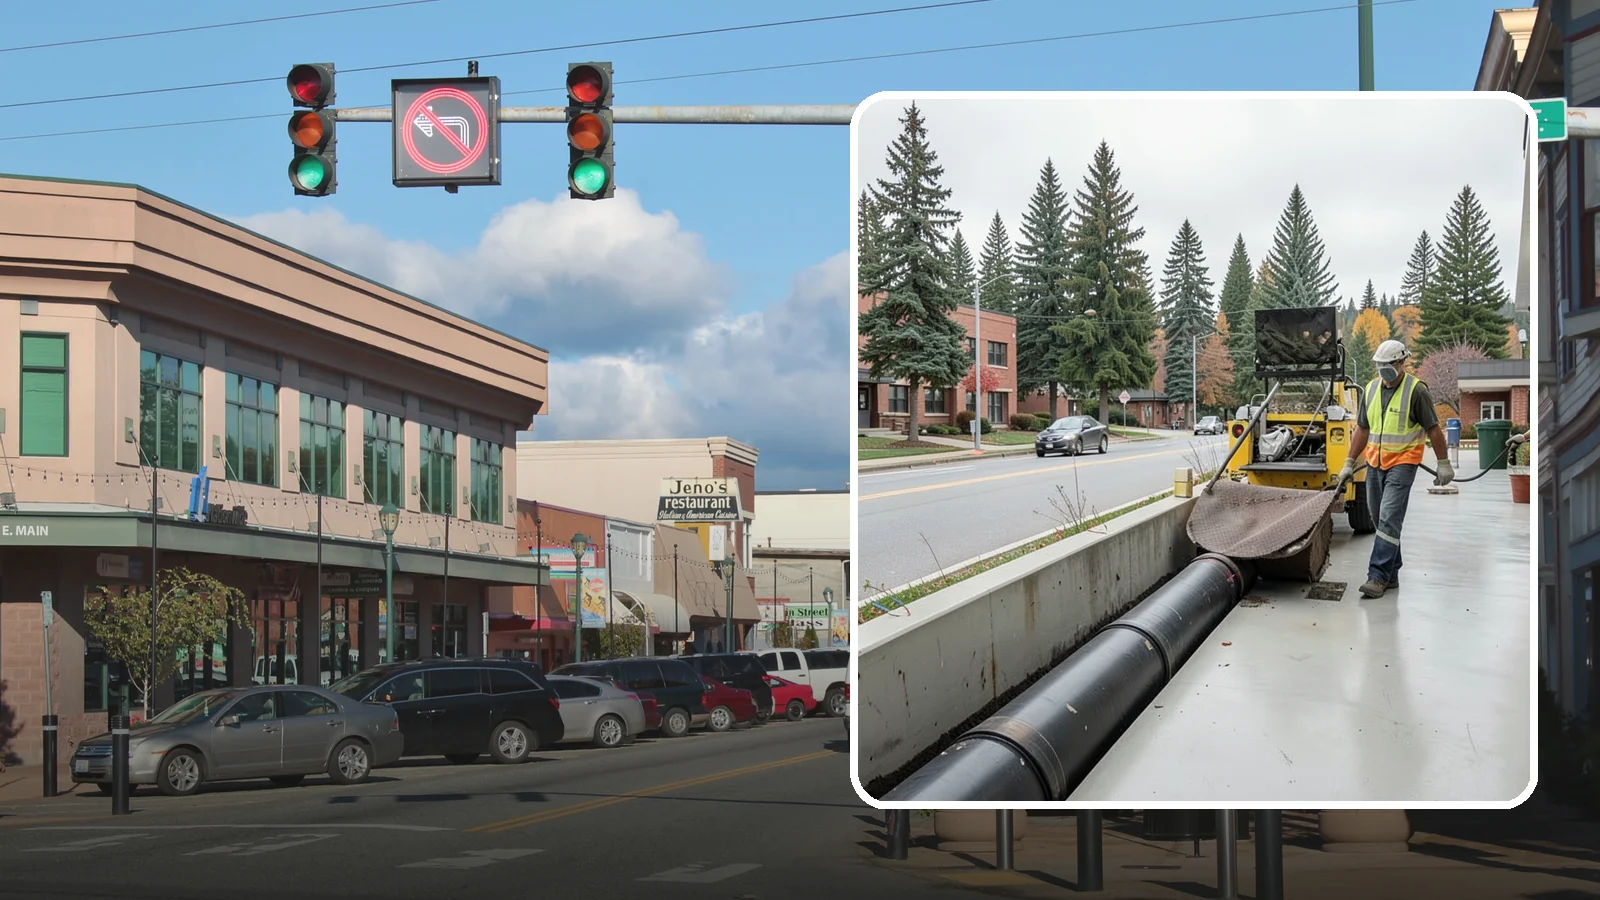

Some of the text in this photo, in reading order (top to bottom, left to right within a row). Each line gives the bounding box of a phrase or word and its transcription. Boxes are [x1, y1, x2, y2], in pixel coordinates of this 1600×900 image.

[669, 480, 728, 494] Jeno's
[665, 496, 731, 509] restaurant
[658, 510, 682, 520] Italian
[686, 510, 714, 519] American
[715, 509, 737, 519] Cuisine
[2, 525, 49, 536] E. MAIN
[797, 607, 828, 617] Street
[791, 619, 823, 627] lass
